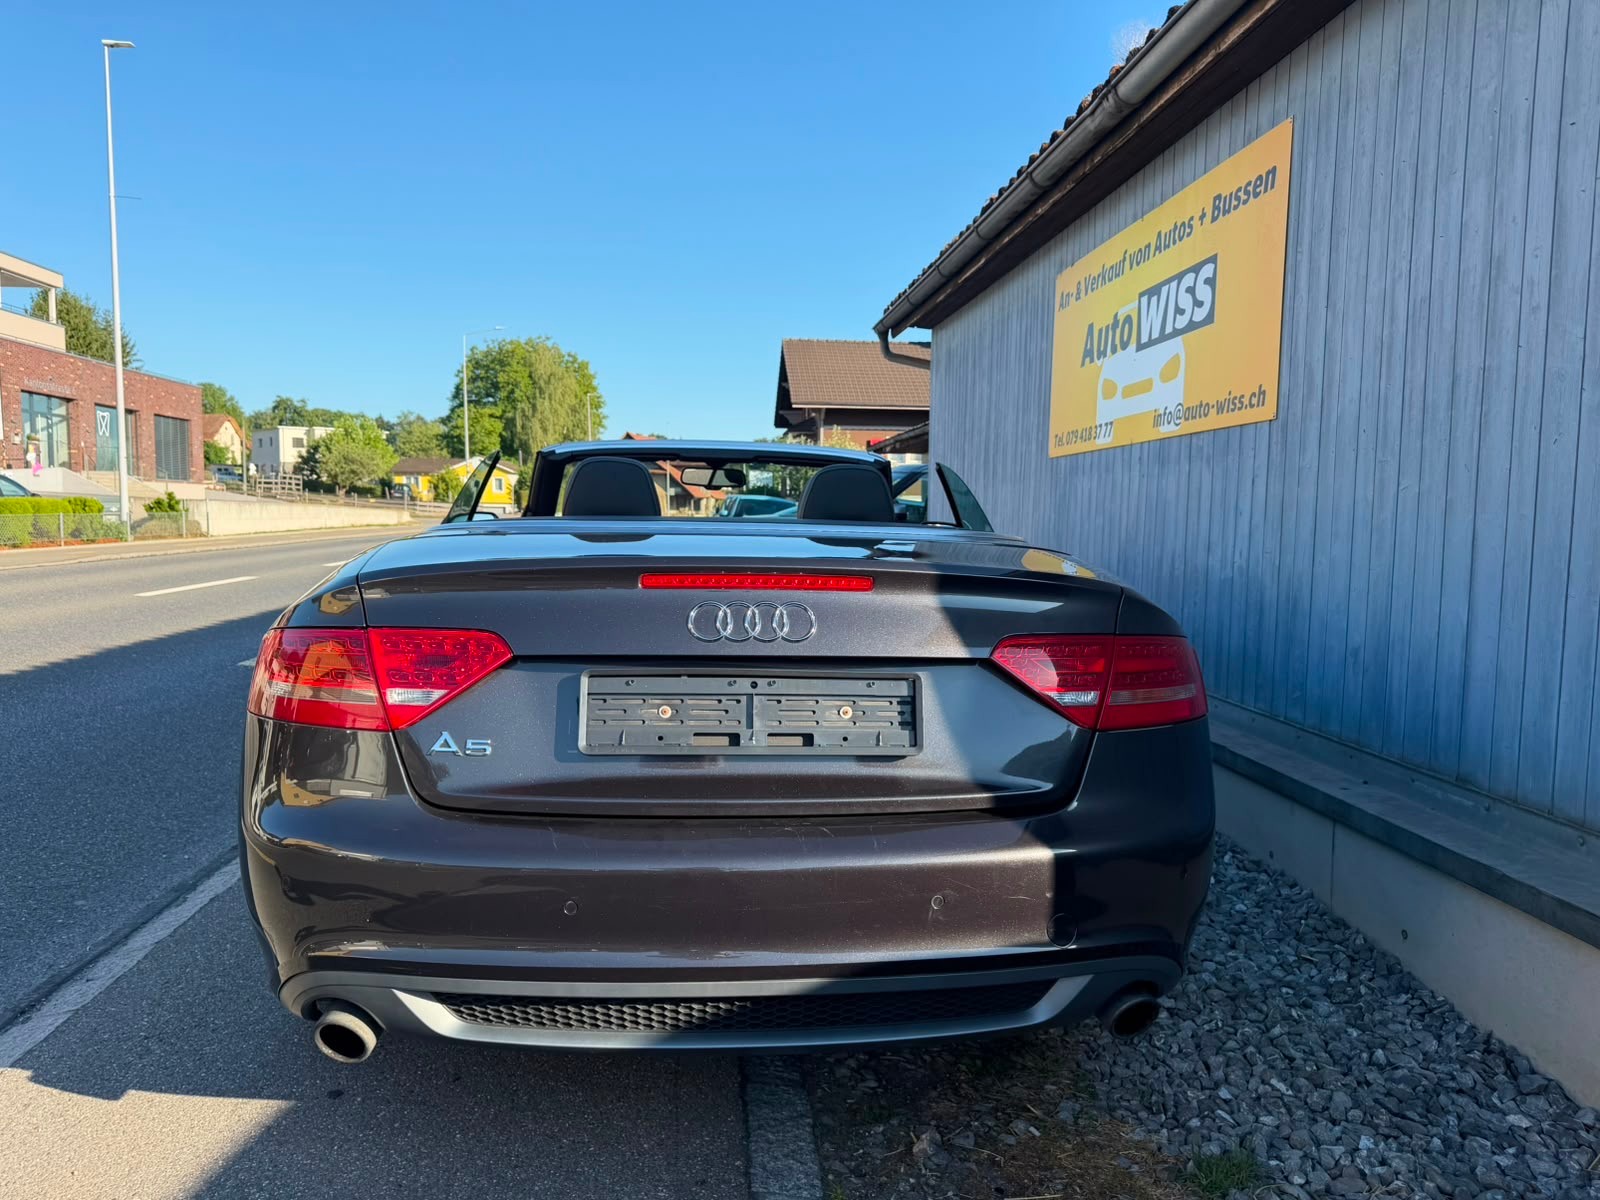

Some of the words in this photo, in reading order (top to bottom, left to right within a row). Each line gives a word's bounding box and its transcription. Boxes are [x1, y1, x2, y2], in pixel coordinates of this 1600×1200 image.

[1058, 291, 1074, 312] An-
[1075, 281, 1082, 302] &
[1084, 249, 1128, 296] Verkauf
[1129, 242, 1151, 271] von
[1153, 215, 1194, 258] Autos
[1198, 207, 1207, 226] +
[1210, 165, 1277, 224] Bussen
[1080, 311, 1133, 368] Auto
[1140, 262, 1216, 345] WISS
[1153, 384, 1266, 428] info@auto-wiss.ch
[1103, 421, 1114, 439] 77
[427, 731, 492, 757] A5
